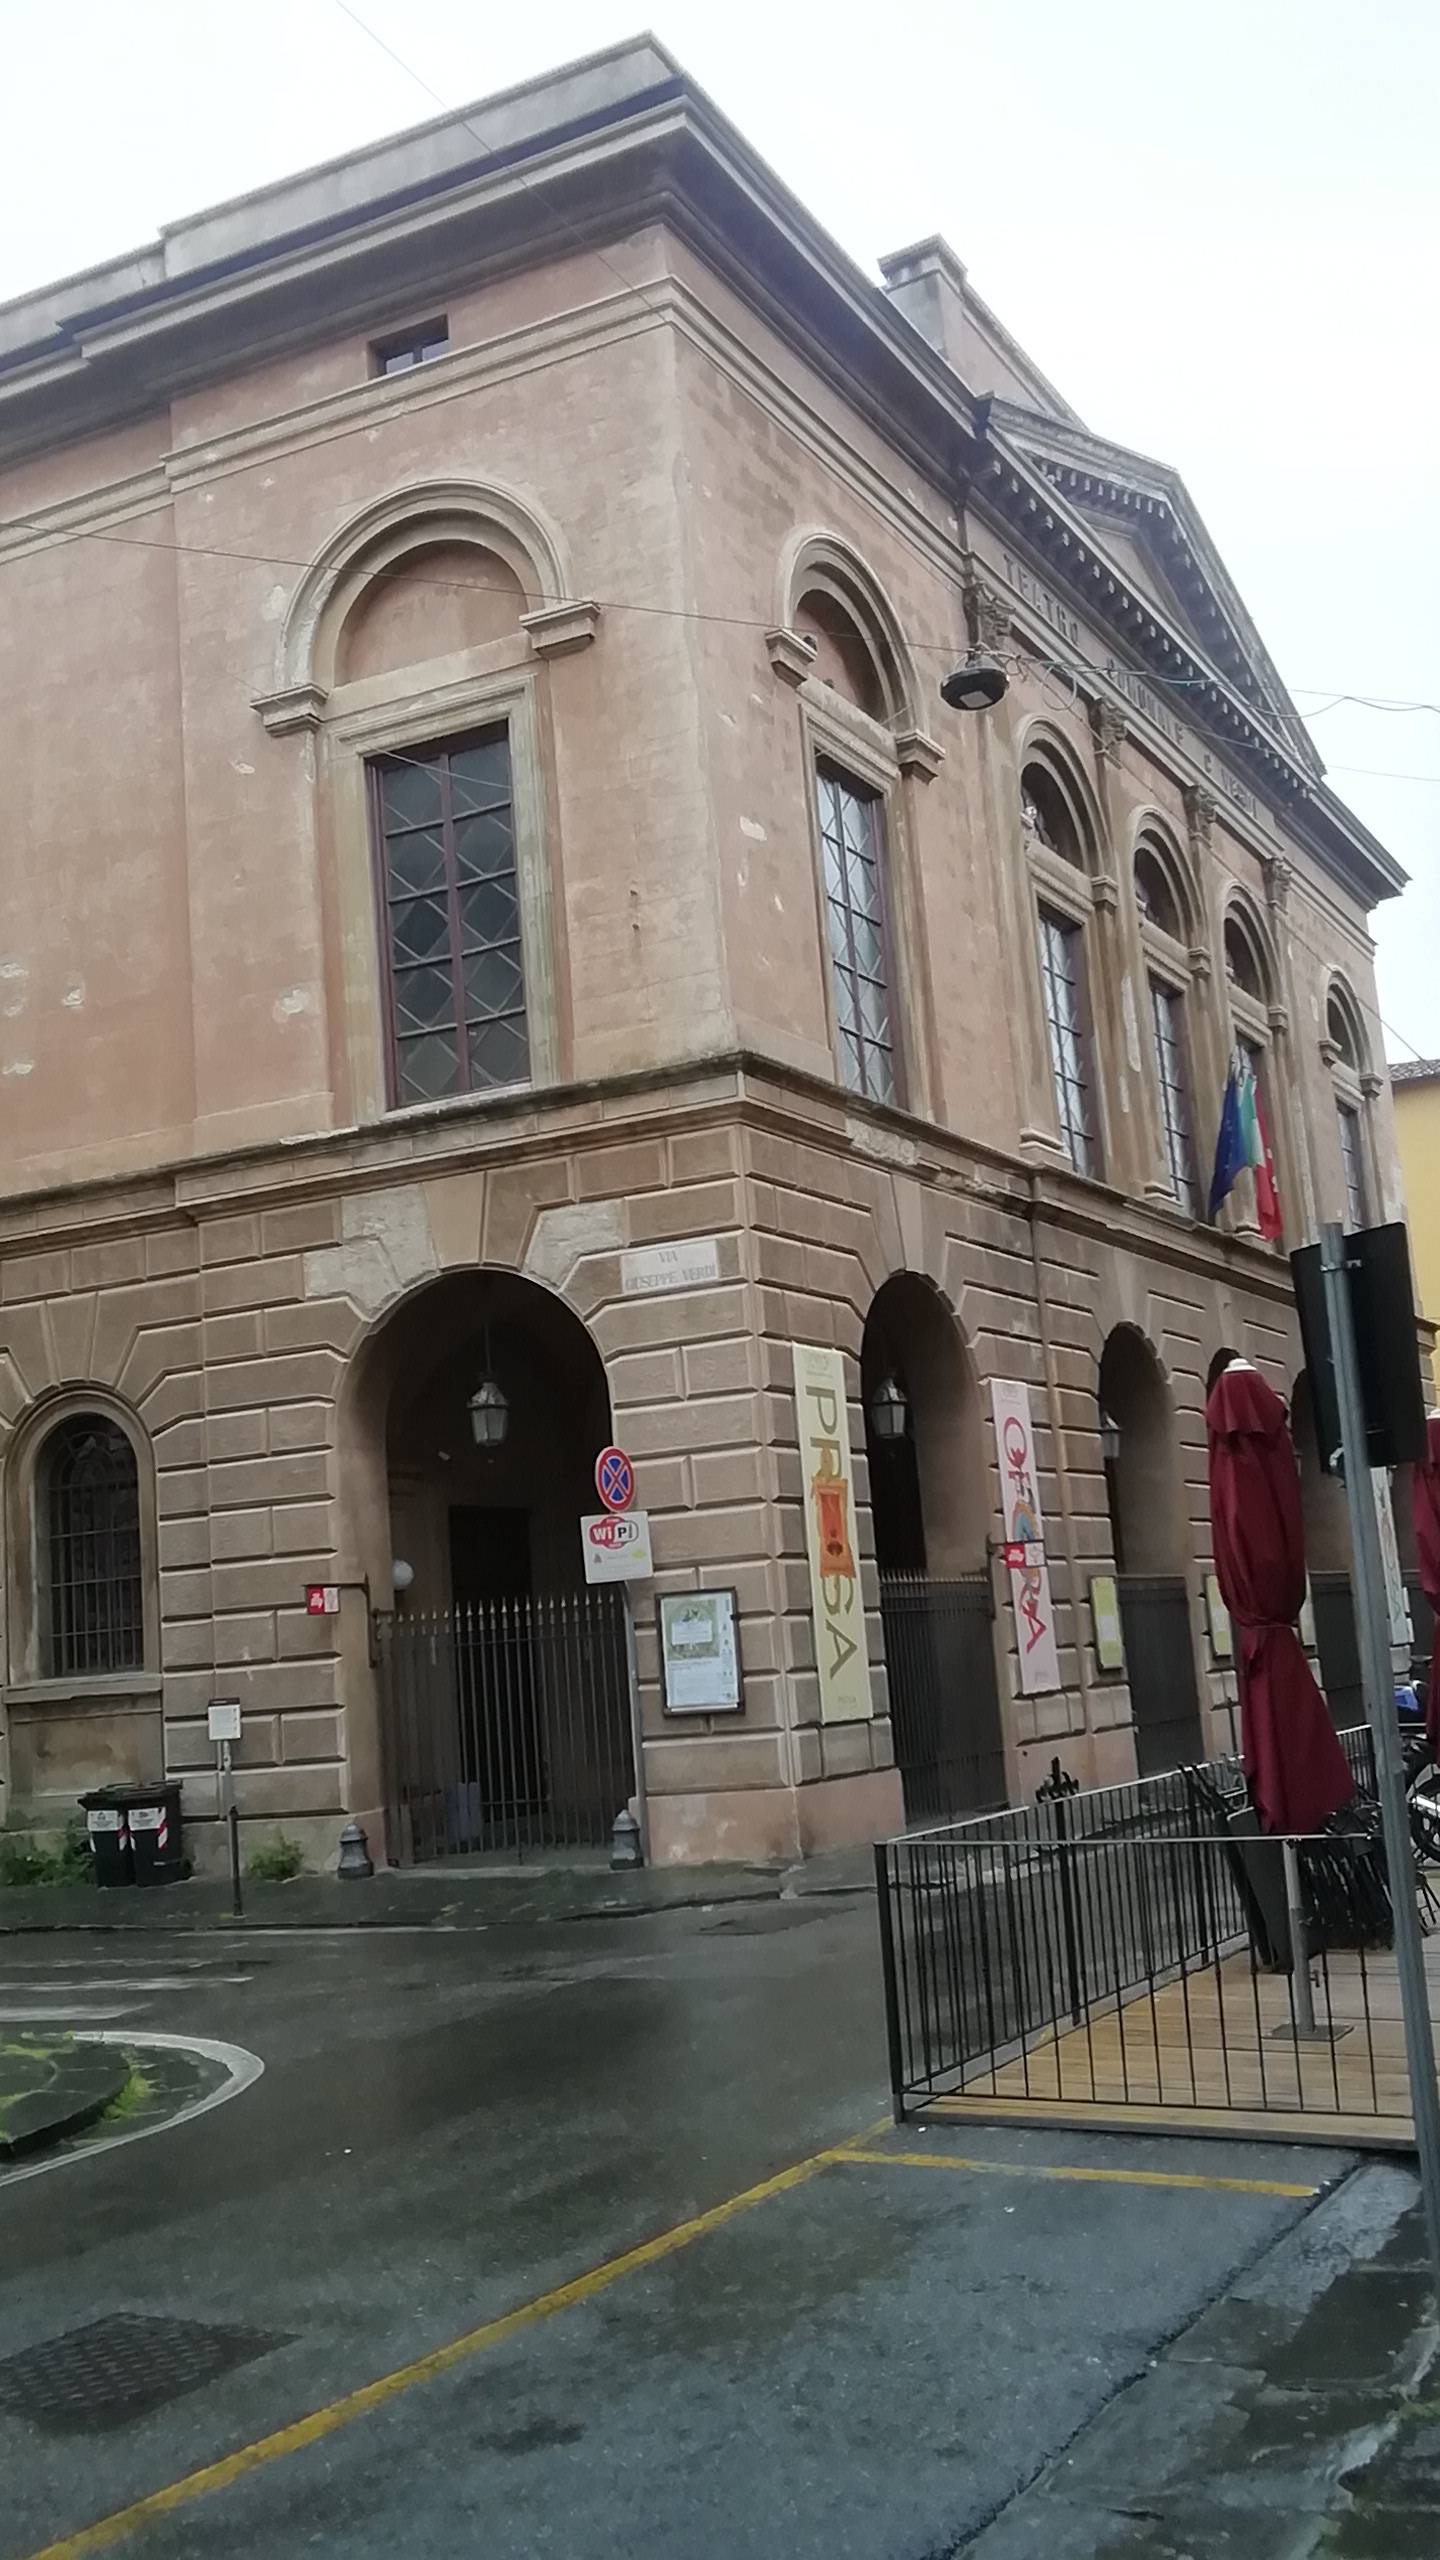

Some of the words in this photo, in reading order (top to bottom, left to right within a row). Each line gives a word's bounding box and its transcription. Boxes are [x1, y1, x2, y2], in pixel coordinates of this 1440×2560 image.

[1003, 553, 1079, 648] TEATRO
[658, 1249, 679, 1264] VIA
[682, 1263, 717, 1281] VERDI
